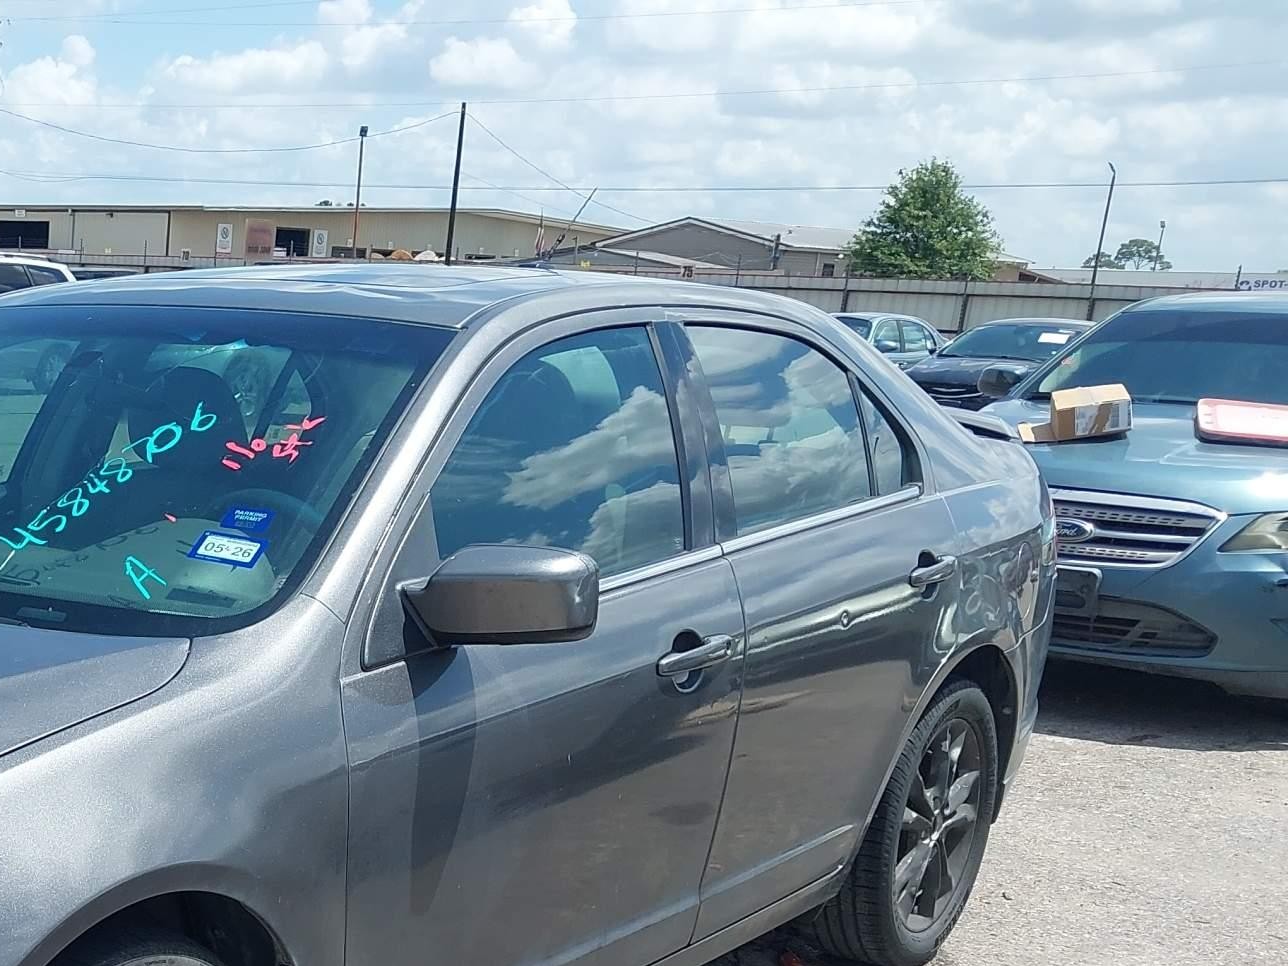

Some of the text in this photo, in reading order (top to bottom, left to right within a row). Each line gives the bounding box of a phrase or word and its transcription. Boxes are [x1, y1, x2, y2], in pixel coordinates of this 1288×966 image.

[234, 509, 267, 519] PARKING
[234, 514, 262, 522] PERMIT
[125, 556, 167, 600] A
